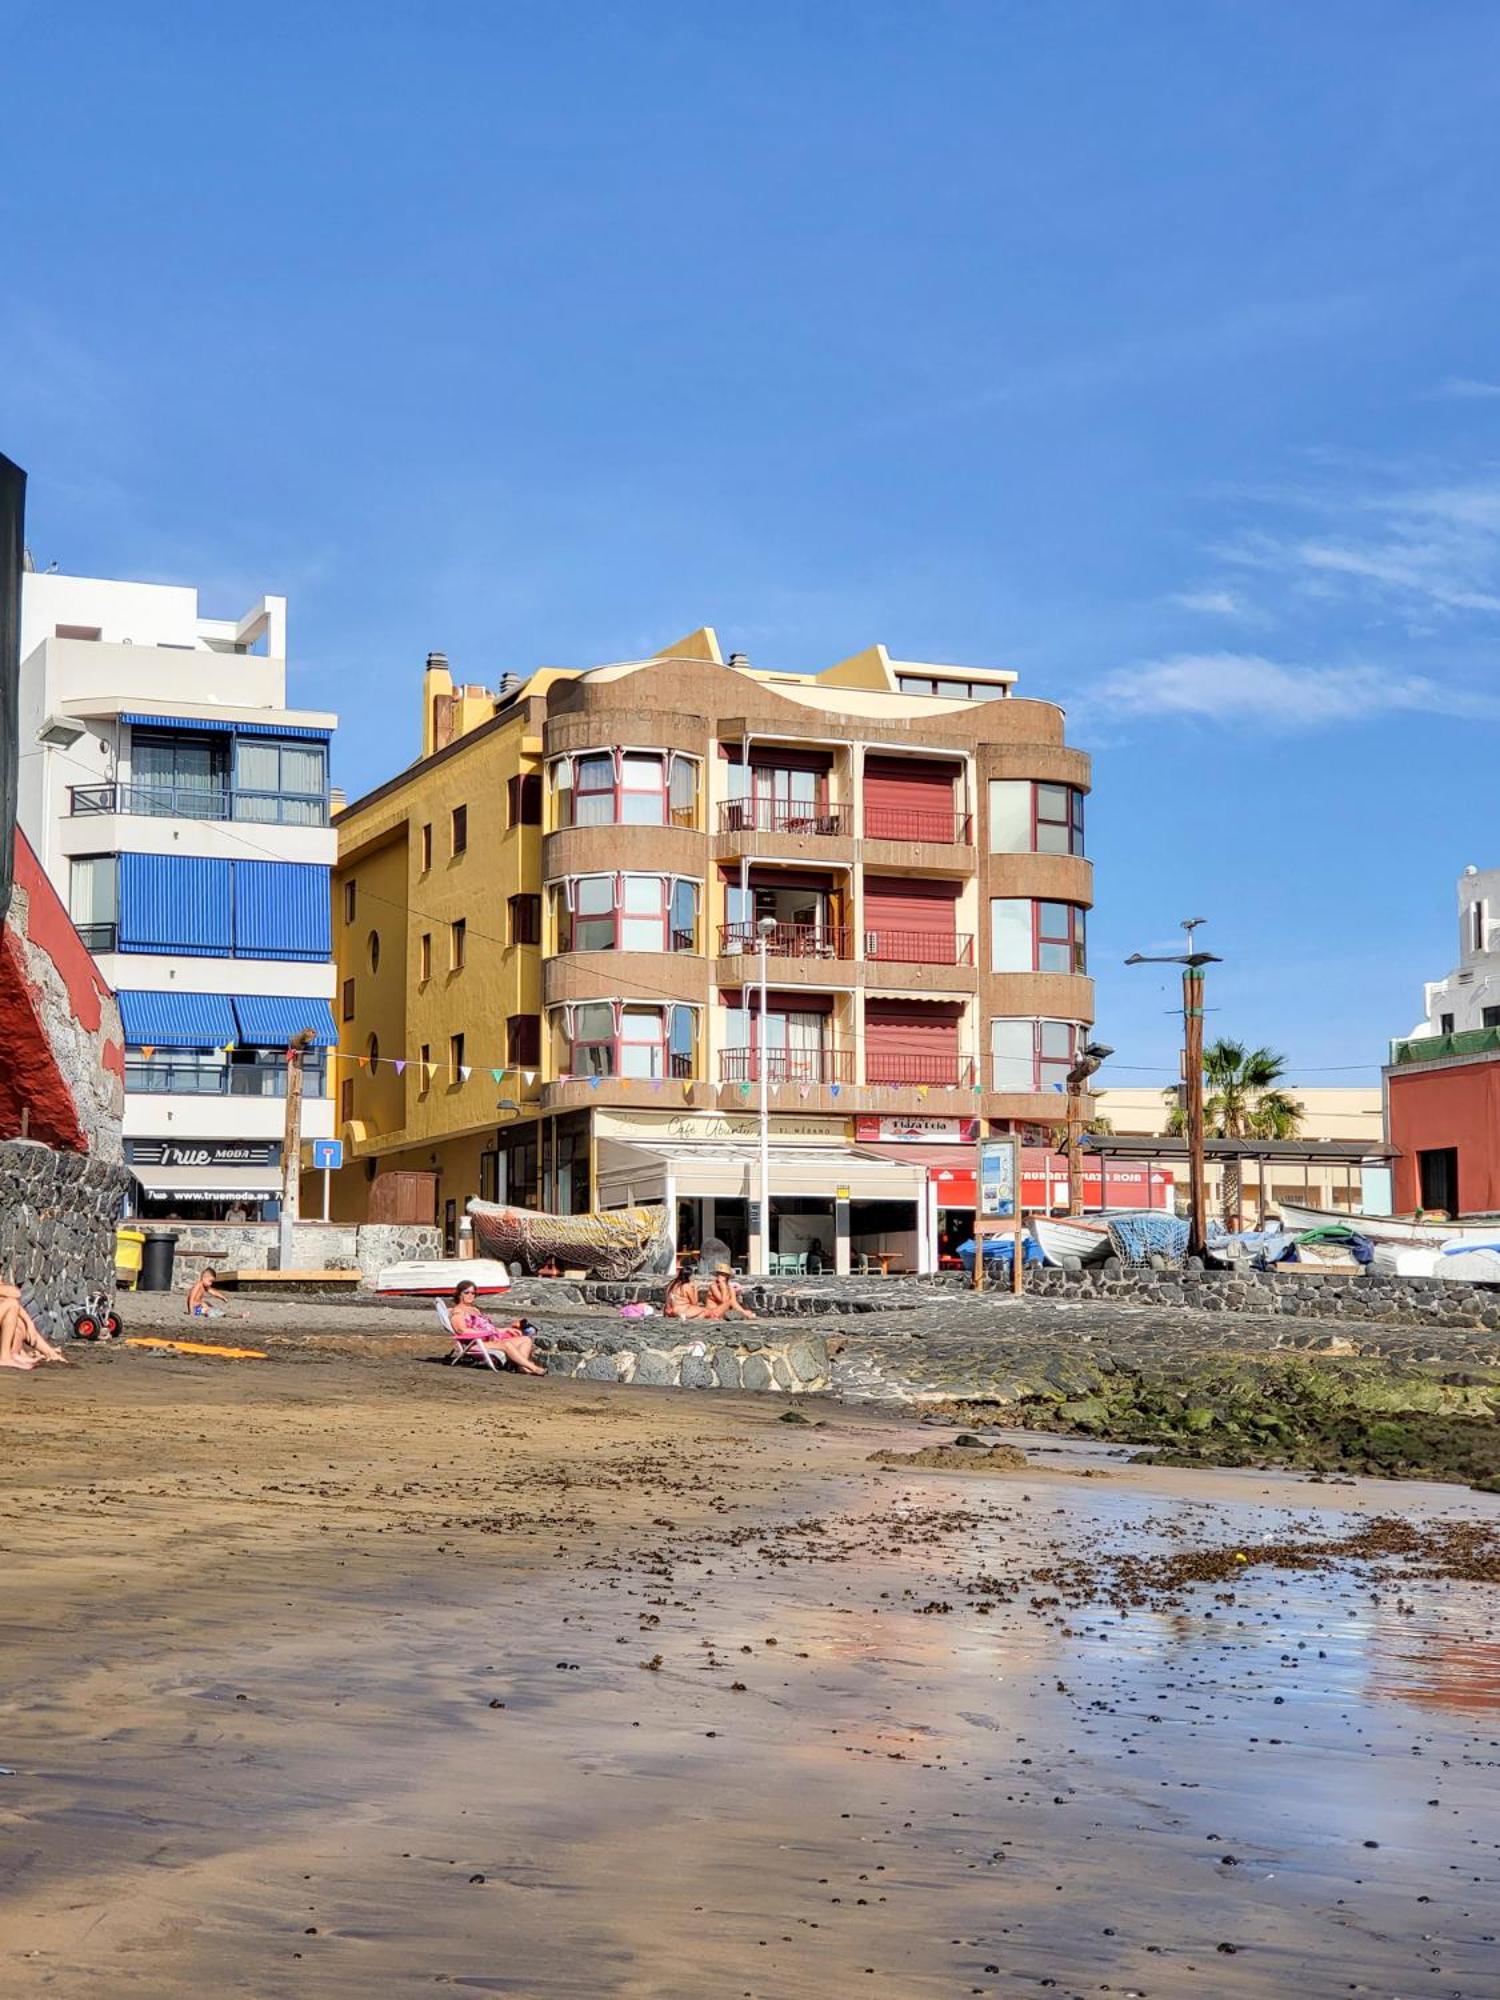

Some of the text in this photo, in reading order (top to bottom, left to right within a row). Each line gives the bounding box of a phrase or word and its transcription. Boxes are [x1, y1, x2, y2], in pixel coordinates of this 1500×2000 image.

[161, 1144, 250, 1165] True MODA
[1113, 1173, 1142, 1182] ROJA
[174, 1191, 270, 1201] www.truemoda.es
